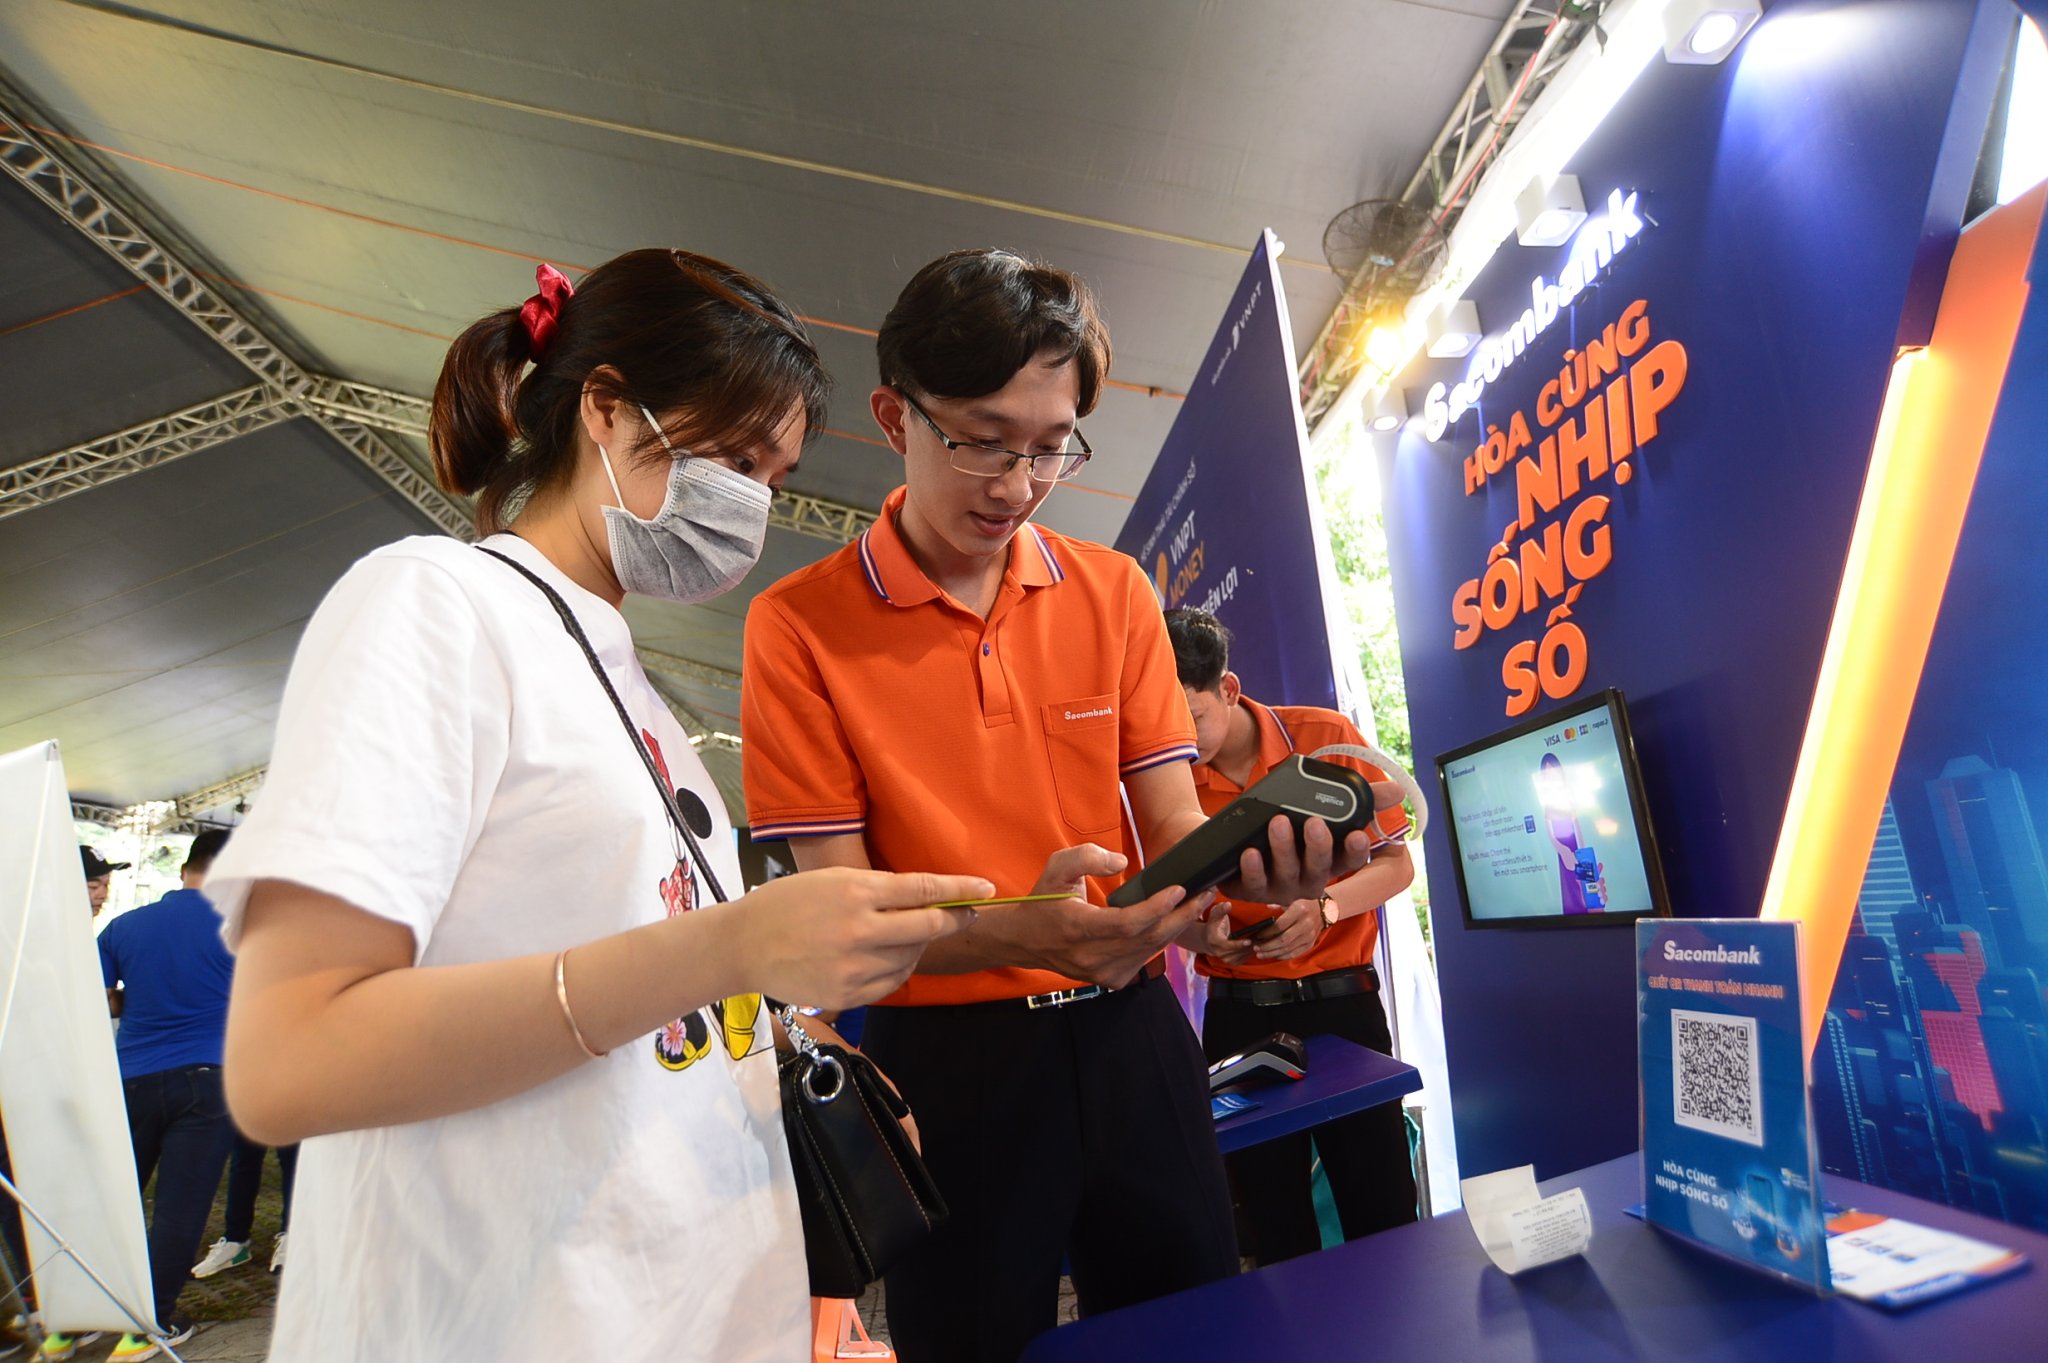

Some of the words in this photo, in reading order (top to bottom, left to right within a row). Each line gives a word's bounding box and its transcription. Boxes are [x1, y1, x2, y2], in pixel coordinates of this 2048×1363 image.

[1239, 281, 1261, 329] VNPT
[1424, 188, 1643, 443] Sacombank
[1464, 410, 1533, 496] HÒA
[1537, 300, 1650, 427] CÙNG
[1516, 340, 1687, 531] NHỊP
[1170, 510, 1195, 565] VNPT
[1170, 540, 1204, 608] MONEY
[1221, 566, 1238, 600] LỢI
[1452, 495, 1613, 650] SỐNG
[1502, 582, 1588, 717] SỐ
[1064, 706, 1113, 720] Sacombank
[1544, 734, 1561, 747] VISA
[1663, 940, 1760, 965] Sacombank
[1655, 1174, 1678, 1193] NHỊP
[1680, 1182, 1710, 1205] SỐNG
[1712, 1193, 1729, 1210] SỐ
[1663, 1159, 1684, 1178] HÒA
[1686, 1167, 1717, 1188] CÙNG
